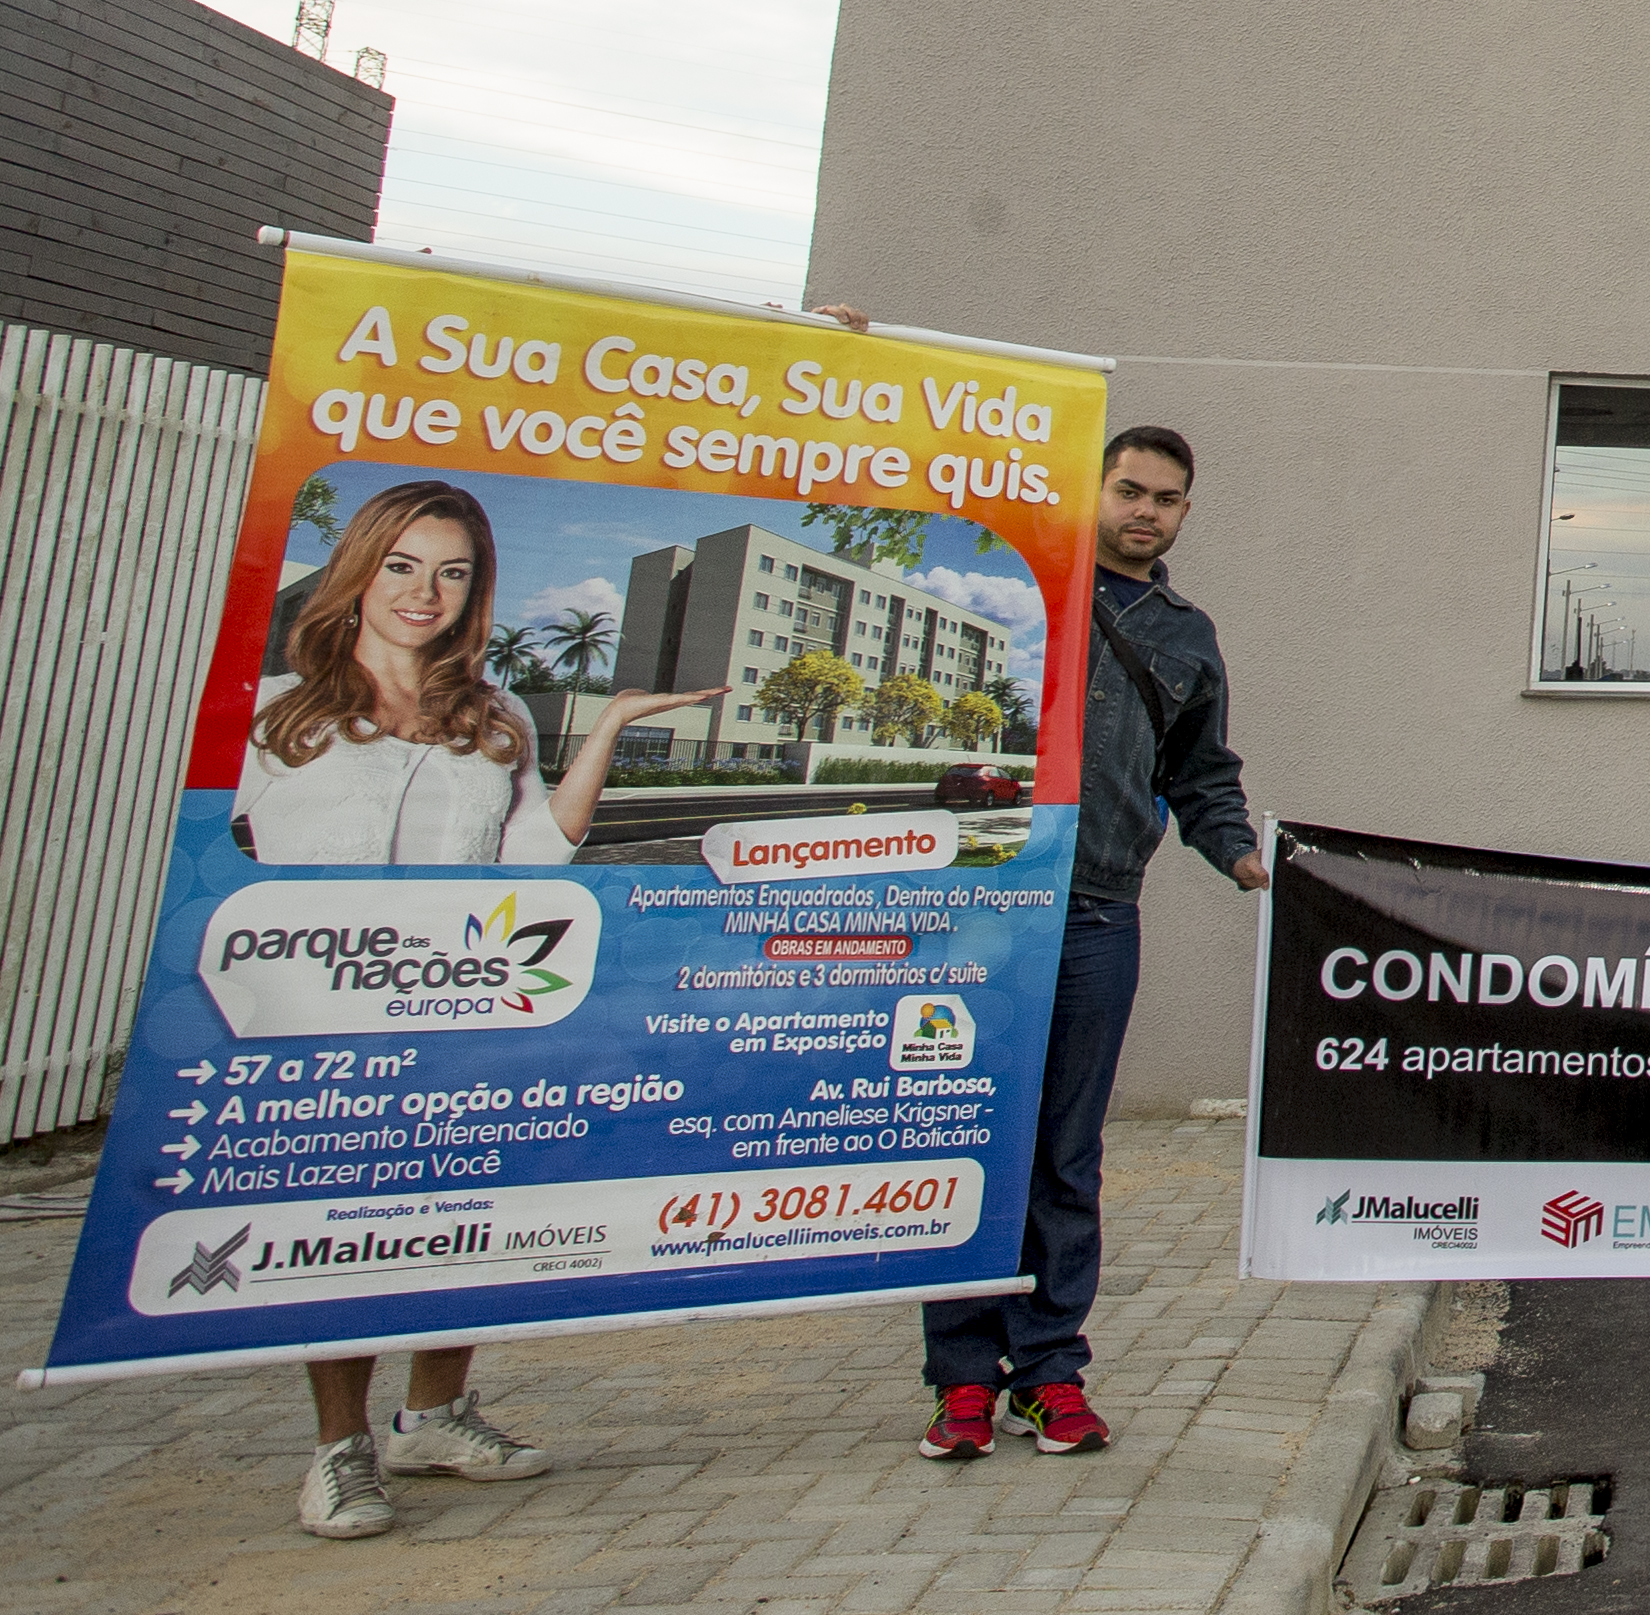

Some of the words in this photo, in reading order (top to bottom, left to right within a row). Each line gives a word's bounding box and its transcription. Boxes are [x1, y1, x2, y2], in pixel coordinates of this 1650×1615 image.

[339, 306, 398, 367] A
[420, 315, 561, 384] Sua
[585, 336, 763, 417] Casa,
[782, 361, 903, 423] Sua
[922, 376, 1052, 443] Vida
[312, 388, 460, 452] que
[484, 403, 646, 463] você
[664, 424, 908, 494] sempre
[928, 448, 1061, 508] quis.
[733, 829, 936, 868] Lançamento
[629, 884, 755, 908] Apartamentos
[886, 885, 945, 907] Dentro
[948, 886, 969, 907] do
[972, 886, 1055, 911] Programa
[724, 912, 789, 934] MINHA
[794, 911, 841, 933] CASA
[844, 911, 907, 934] MINHA
[219, 925, 399, 971] parque
[401, 934, 431, 948] das
[771, 940, 812, 956] OBRAS
[814, 940, 834, 955] EM
[834, 940, 907, 956] ANDAMENTO
[330, 951, 509, 996] nações
[677, 968, 689, 989] 2
[693, 962, 797, 988] dormitórios
[799, 970, 811, 986] e
[813, 964, 826, 986] 3
[829, 962, 926, 986] dormitórios
[930, 962, 945, 984] c/
[948, 964, 988, 984] suite
[386, 994, 495, 1020] europa
[645, 1014, 711, 1034] Visite
[716, 1017, 731, 1032] o
[734, 1011, 890, 1036] Apartamento
[729, 1036, 769, 1053] em
[772, 1031, 888, 1056] Exposição
[901, 1053, 936, 1063] Minha
[938, 1052, 962, 1062] Vida
[902, 1043, 935, 1052] Minha
[938, 1042, 964, 1051] Casa
[1316, 1037, 1389, 1072] 624
[223, 1054, 269, 1086] 57
[279, 1059, 304, 1082] a
[312, 1051, 354, 1082] 72
[216, 1095, 246, 1126] A
[255, 1088, 390, 1123] melhor
[401, 1081, 514, 1121] opção
[521, 1079, 569, 1108] da
[575, 1073, 685, 1112] região
[810, 1079, 844, 1101] Av.
[852, 1076, 890, 1098] Rui
[896, 1074, 997, 1099] Barbosa,
[207, 1125, 408, 1161] Acabamento
[413, 1113, 589, 1148] Diferenciado
[668, 1115, 717, 1139] esq.
[723, 1114, 775, 1132] com
[778, 1103, 889, 1131] Anneliese
[893, 1101, 983, 1129] Krigsner
[731, 1141, 771, 1159] em
[775, 1133, 840, 1156] frente
[844, 1135, 873, 1153] ao
[878, 1128, 897, 1151] O
[901, 1125, 992, 1150] Boticário
[200, 1165, 280, 1195] Mais
[285, 1159, 367, 1189] Lazer
[371, 1161, 424, 1188] pra
[430, 1150, 503, 1178] Você
[327, 1201, 415, 1223] Realização
[419, 1204, 431, 1216] e
[434, 1199, 495, 1214] Vendas:
[658, 1191, 742, 1235] (41)
[753, 1176, 960, 1224] 3081.4601
[1352, 1195, 1480, 1223] JMalucelli
[252, 1222, 492, 1272] J.Malucelli
[504, 1224, 608, 1251] IMÓVEIS
[650, 1218, 951, 1257] www.jmalucelliimoveis.com.br
[1413, 1225, 1479, 1241] IMÓVEIS
[533, 1260, 567, 1272] CRECI
